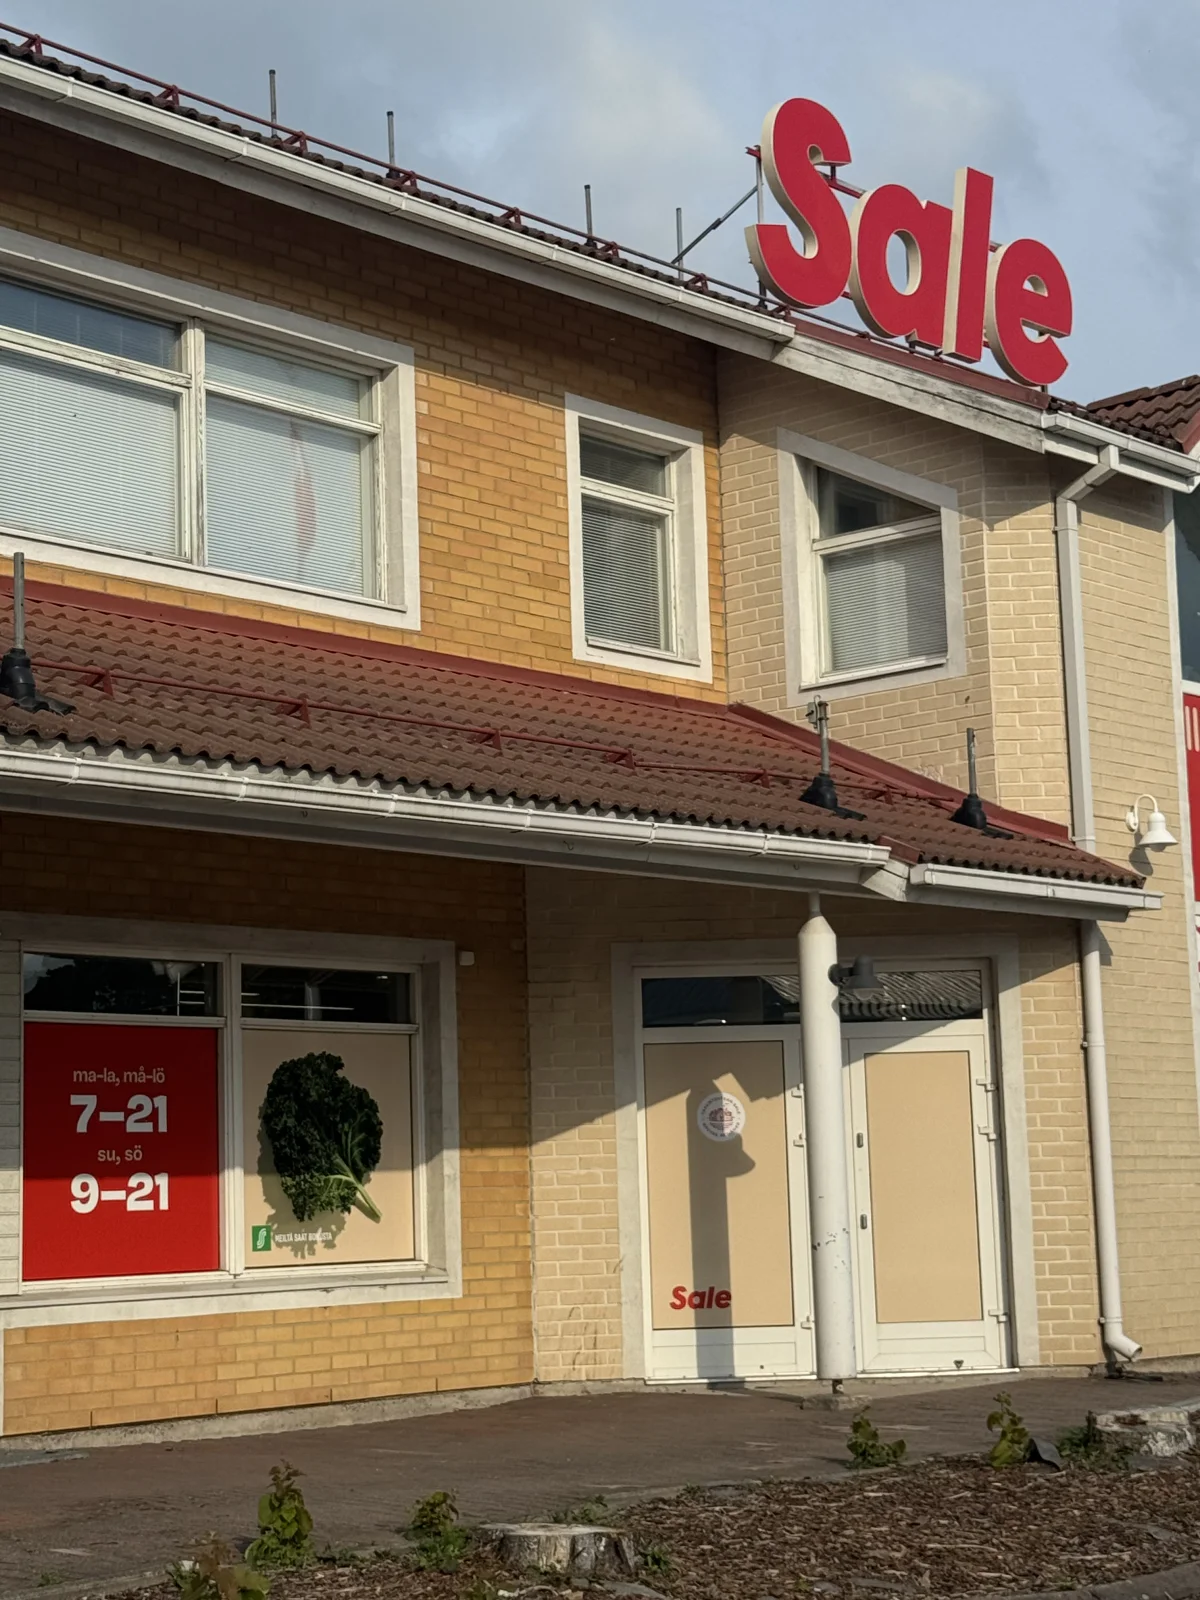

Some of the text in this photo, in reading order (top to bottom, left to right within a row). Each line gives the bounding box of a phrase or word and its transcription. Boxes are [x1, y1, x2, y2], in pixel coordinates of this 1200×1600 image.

[744, 97, 1073, 387] Sale
[73, 1066, 165, 1086] ma-la, må-lö
[97, 1145, 143, 1165] su, sö
[669, 1285, 731, 1310] Sale
